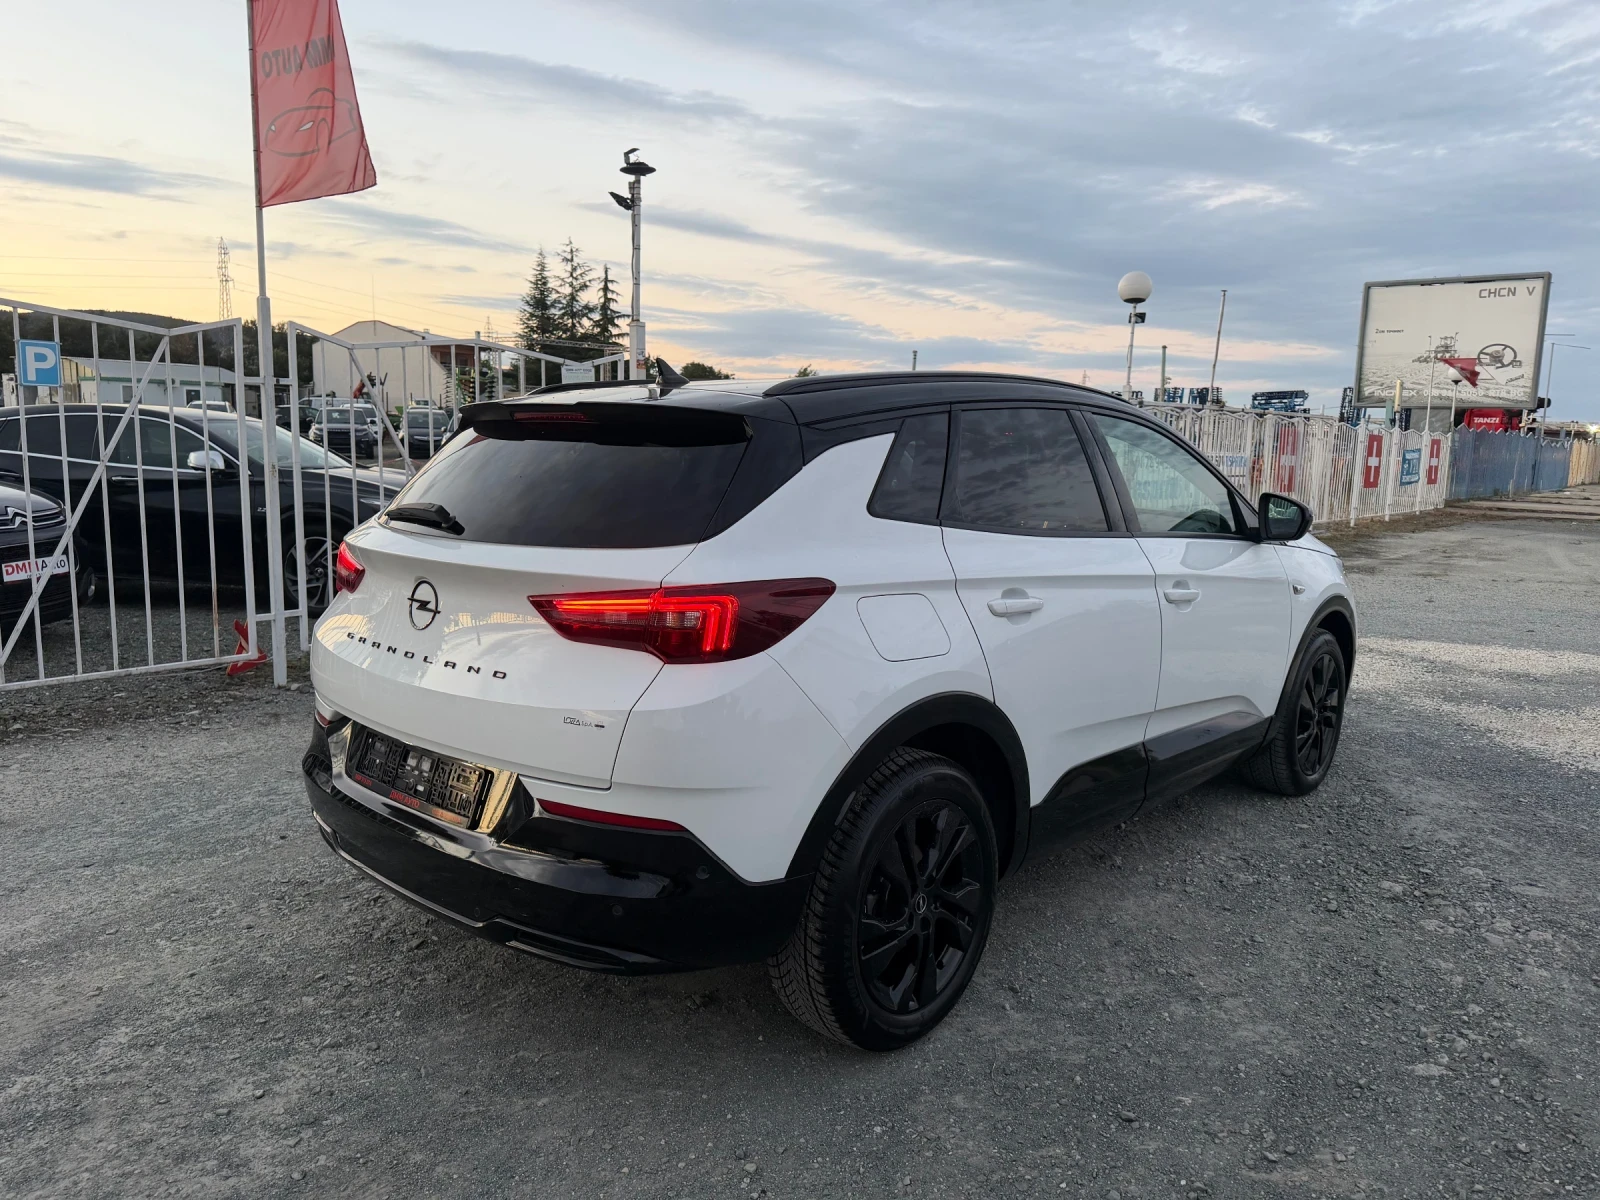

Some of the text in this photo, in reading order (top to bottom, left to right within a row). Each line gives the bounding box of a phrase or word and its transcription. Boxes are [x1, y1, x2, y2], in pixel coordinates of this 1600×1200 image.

[1479, 287, 1516, 298] CHCN
[25, 345, 56, 381] P
[347, 632, 507, 680] GRANDLAND
